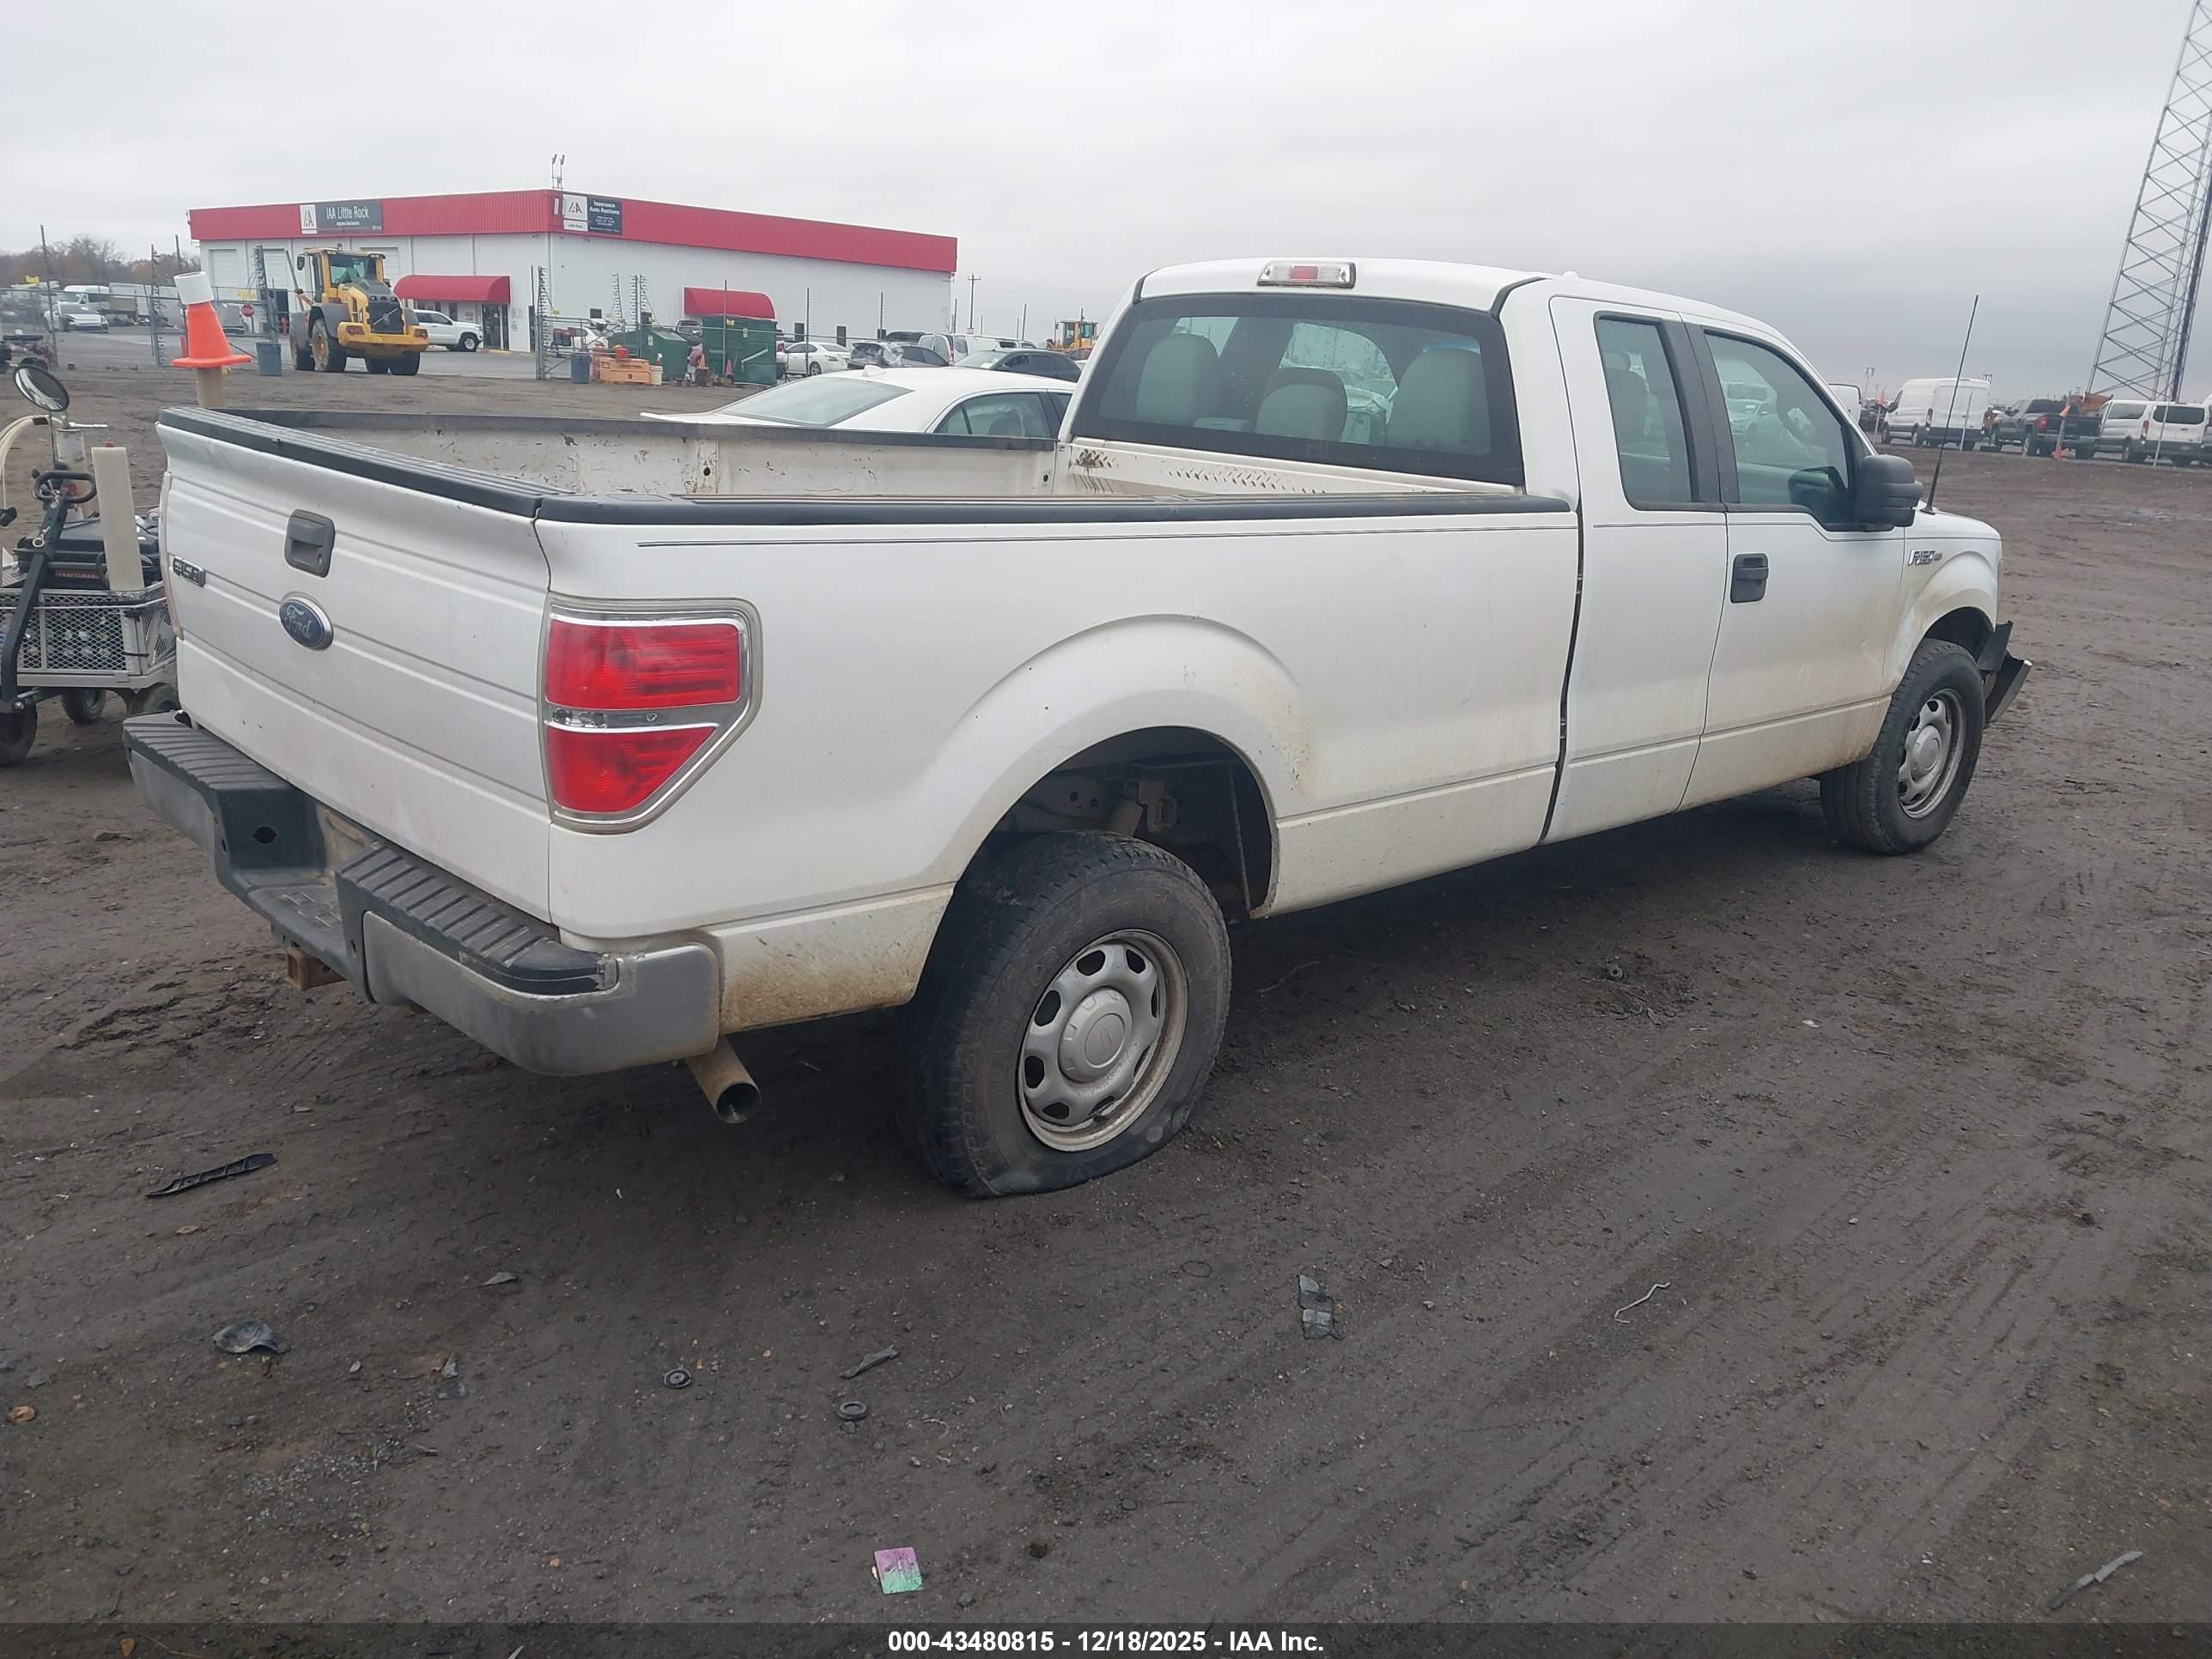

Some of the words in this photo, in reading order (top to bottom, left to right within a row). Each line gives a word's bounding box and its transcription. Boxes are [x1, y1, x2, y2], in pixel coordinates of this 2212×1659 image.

[325, 206, 337, 220] IAA
[337, 206, 353, 220] Little
[353, 205, 369, 219] Rock
[284, 605, 312, 639] Ford
